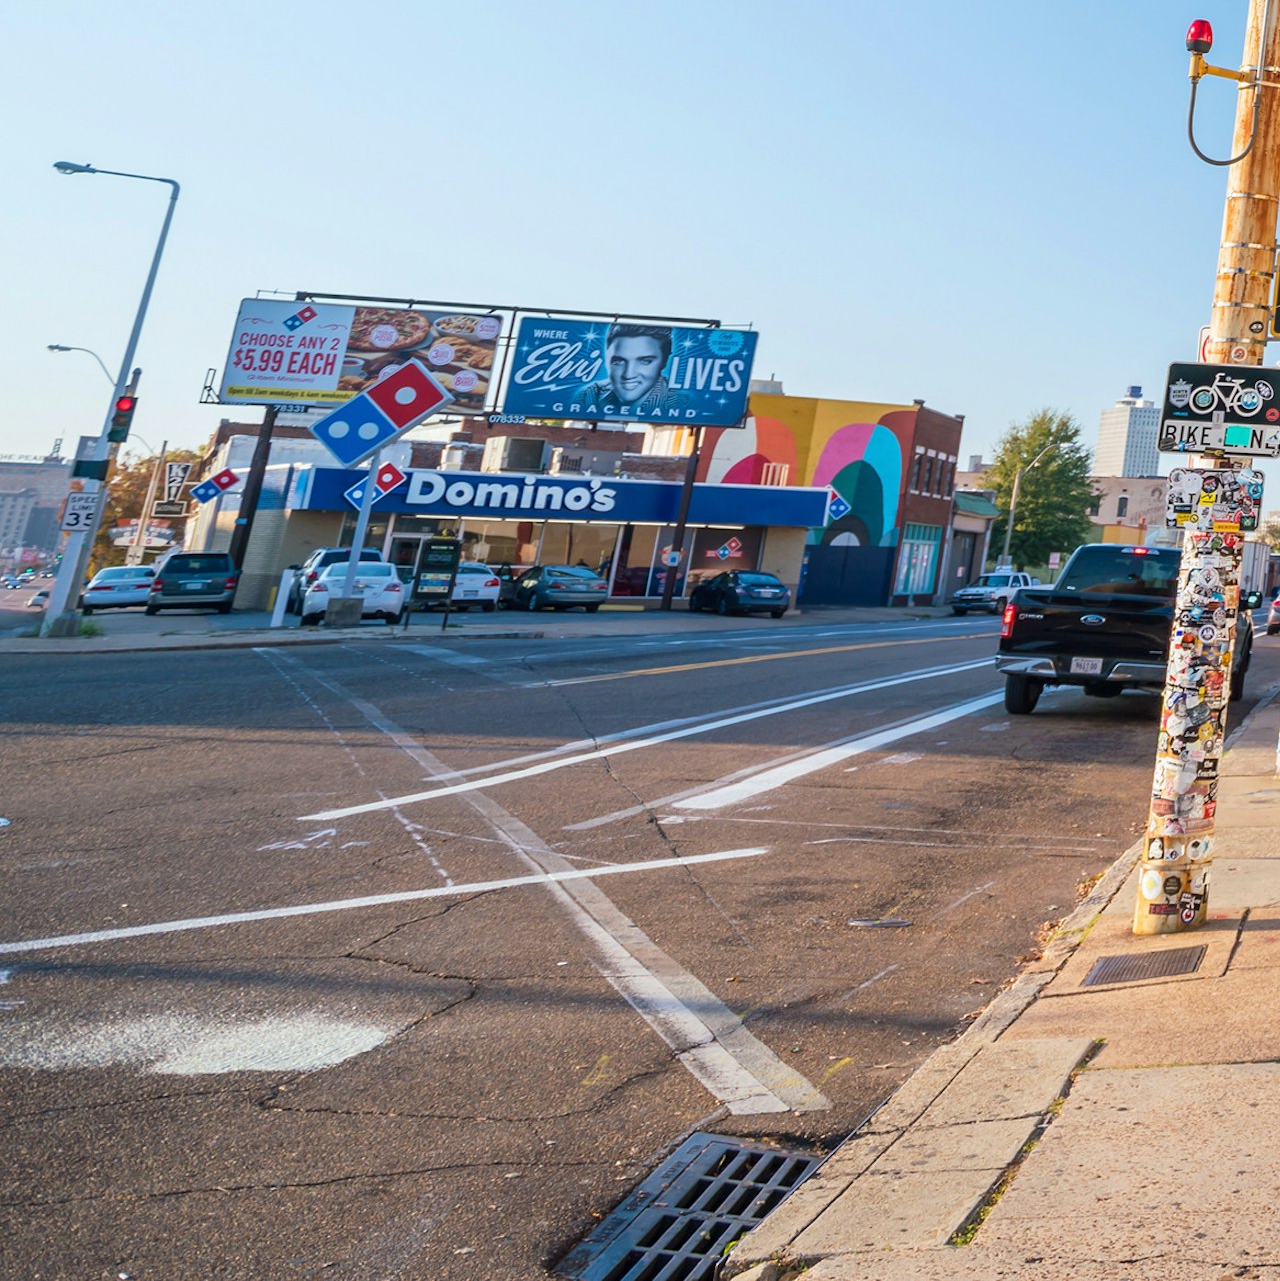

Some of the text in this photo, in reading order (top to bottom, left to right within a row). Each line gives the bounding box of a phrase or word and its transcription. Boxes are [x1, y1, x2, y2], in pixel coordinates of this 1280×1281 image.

[239, 332, 341, 351] CHOOSE ANY 2
[533, 329, 569, 340] WHERE
[233, 348, 337, 376] $5.99 EACH
[514, 342, 603, 385] Elvis
[668, 356, 745, 393] LIVES
[552, 402, 698, 418] GRACELAND
[1165, 425, 1212, 446] BIKE
[70, 496, 99, 504] SPEE
[405, 473, 617, 512] Domino's
